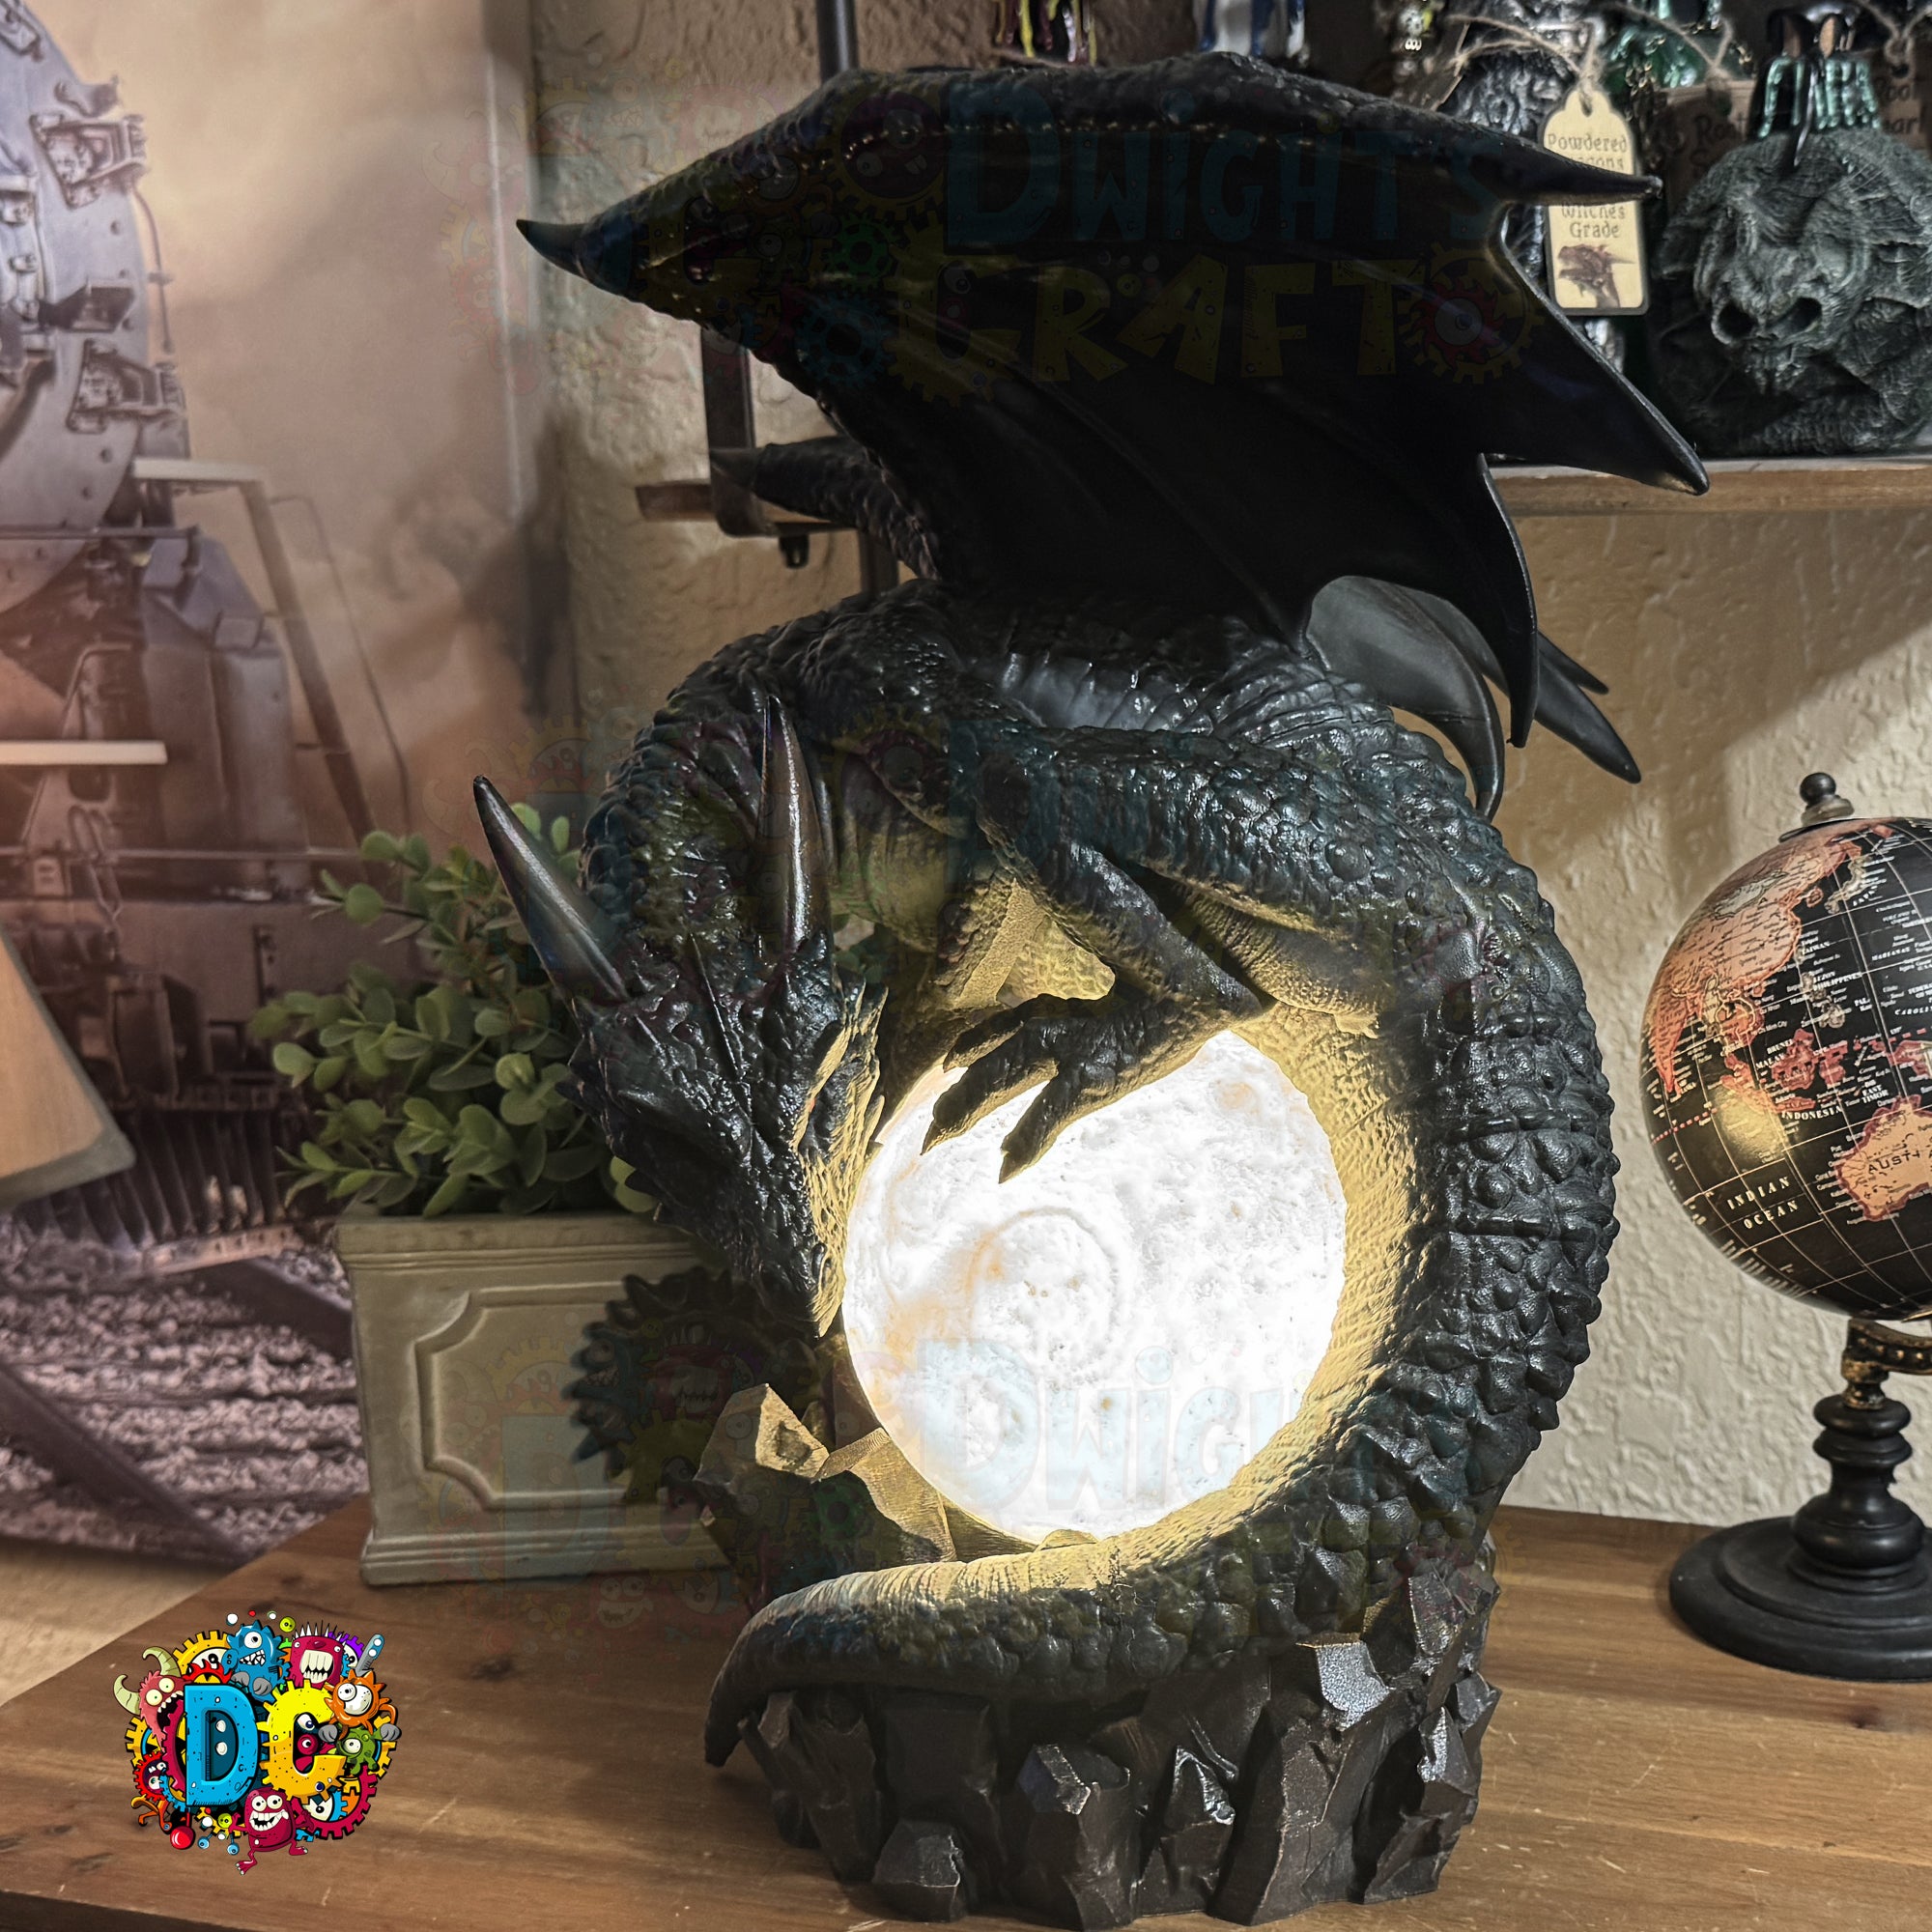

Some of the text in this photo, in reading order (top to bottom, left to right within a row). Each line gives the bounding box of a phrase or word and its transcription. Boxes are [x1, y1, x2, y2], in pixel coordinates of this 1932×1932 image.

[1548, 131, 1628, 153] Powdered
[1569, 221, 1621, 239] Grade
[1780, 1104, 1843, 1122] INDONESIA
[1726, 1176, 1790, 1210] INDIAN
[1743, 1200, 1798, 1229] OCEAN
